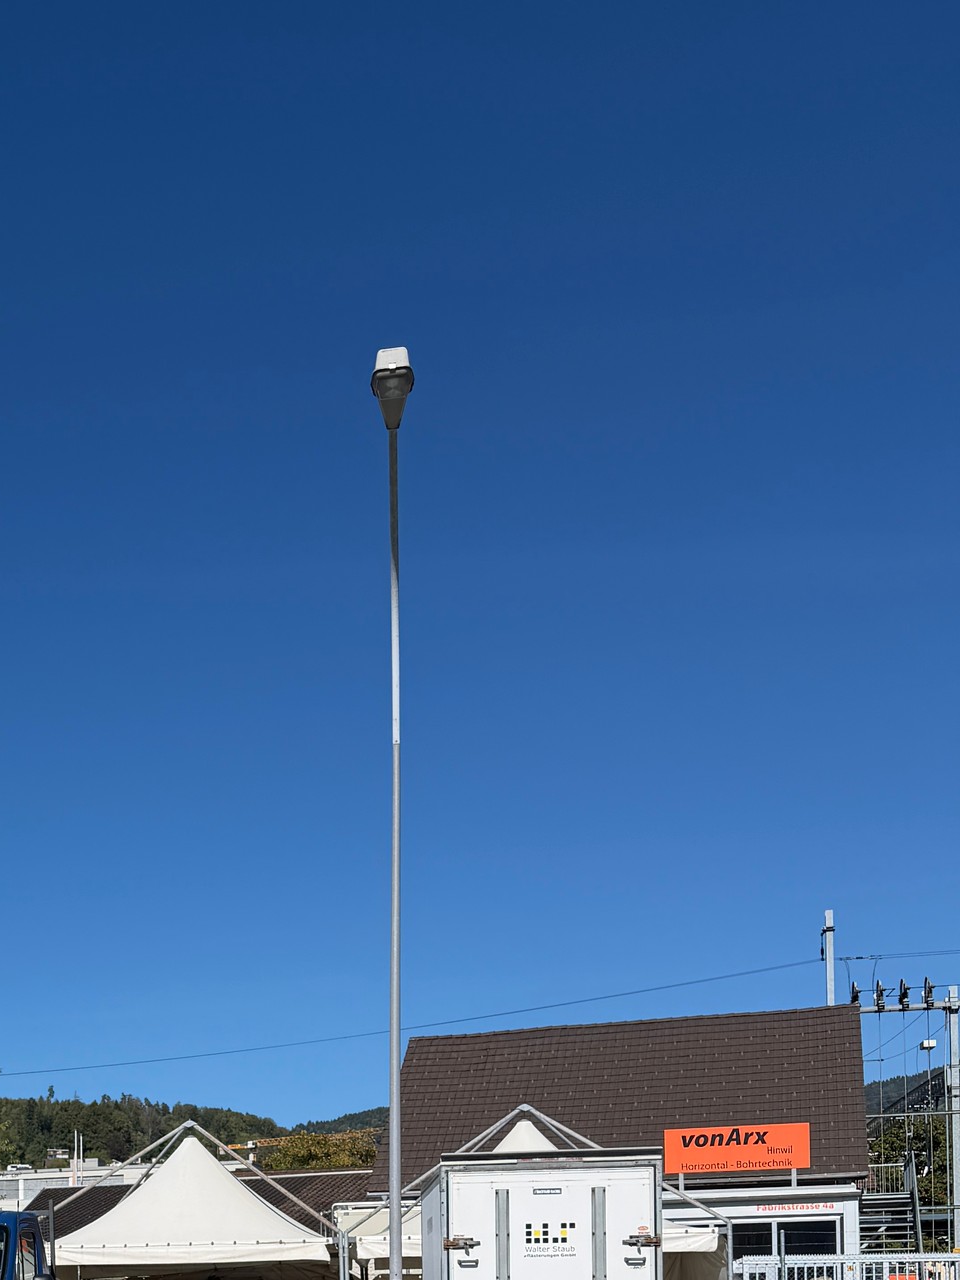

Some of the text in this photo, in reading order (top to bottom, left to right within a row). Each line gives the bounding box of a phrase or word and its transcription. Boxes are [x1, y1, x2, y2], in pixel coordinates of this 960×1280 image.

[681, 1128, 768, 1148] vonArx
[767, 1145, 793, 1155] Hinwil
[681, 1161, 728, 1171] Horizontal
[736, 1158, 793, 1168] Bohrtechnik
[756, 1202, 820, 1211] Fabrikstrasse
